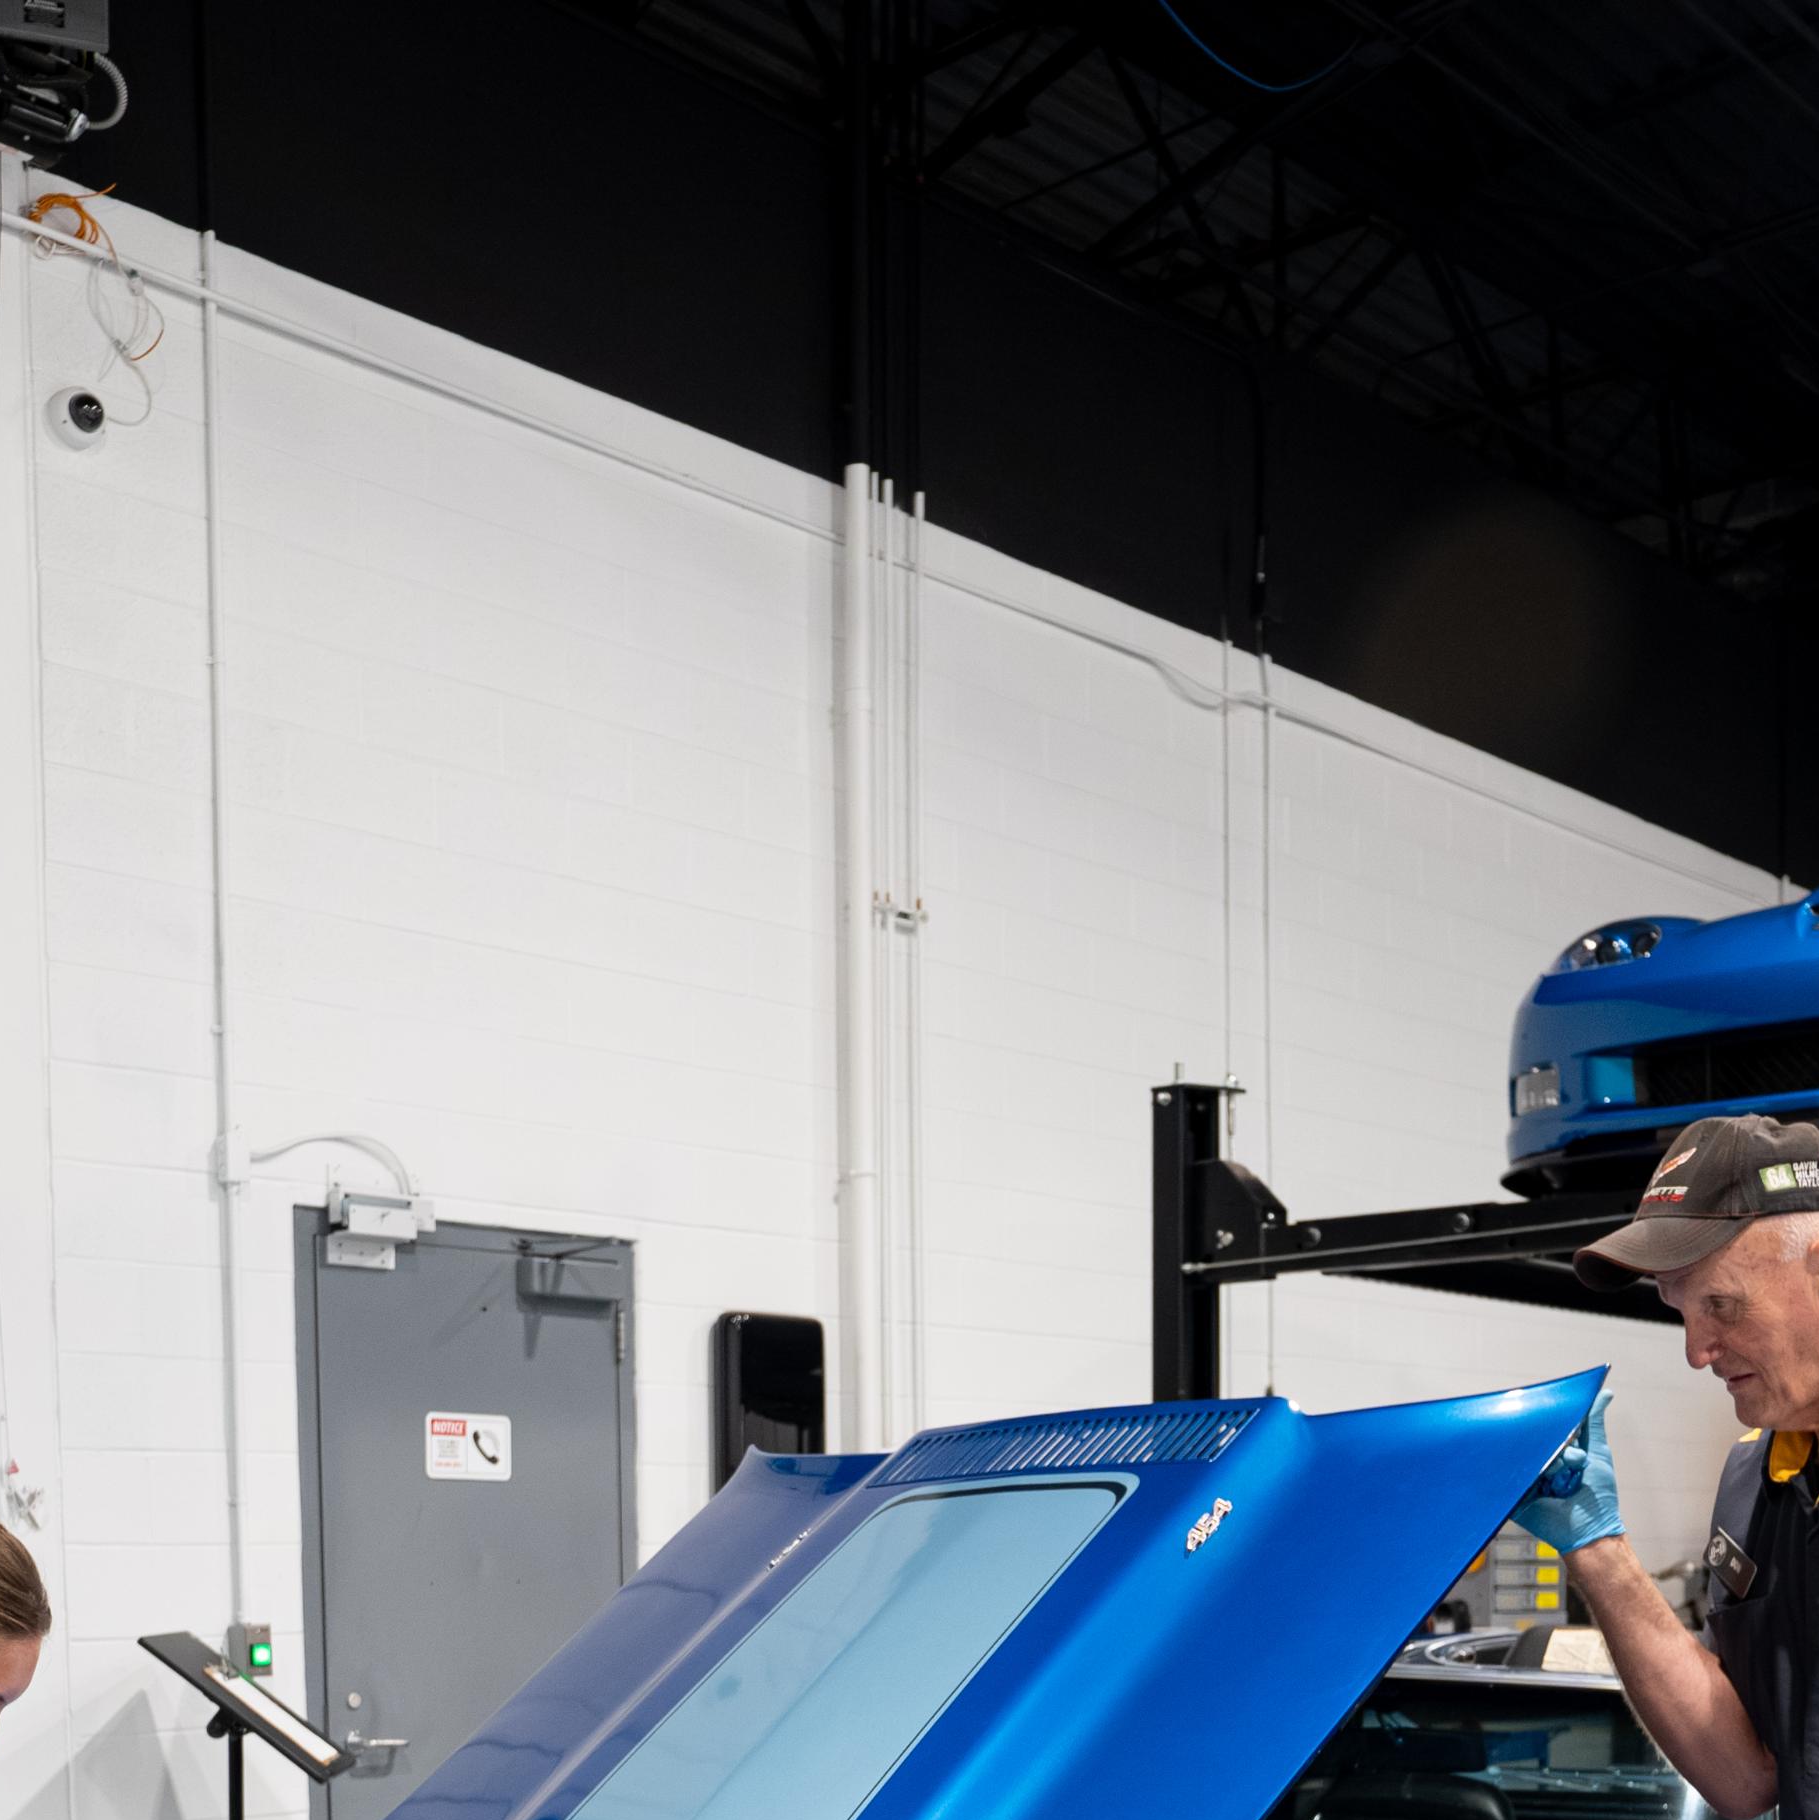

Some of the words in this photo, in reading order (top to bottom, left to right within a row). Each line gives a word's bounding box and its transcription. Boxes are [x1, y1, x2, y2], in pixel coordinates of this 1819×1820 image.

[1793, 1161, 1817, 1171] GAVIN
[1767, 1167, 1792, 1188] 64
[433, 1421, 465, 1434] NOTICE
[1186, 1497, 1233, 1551] 454
